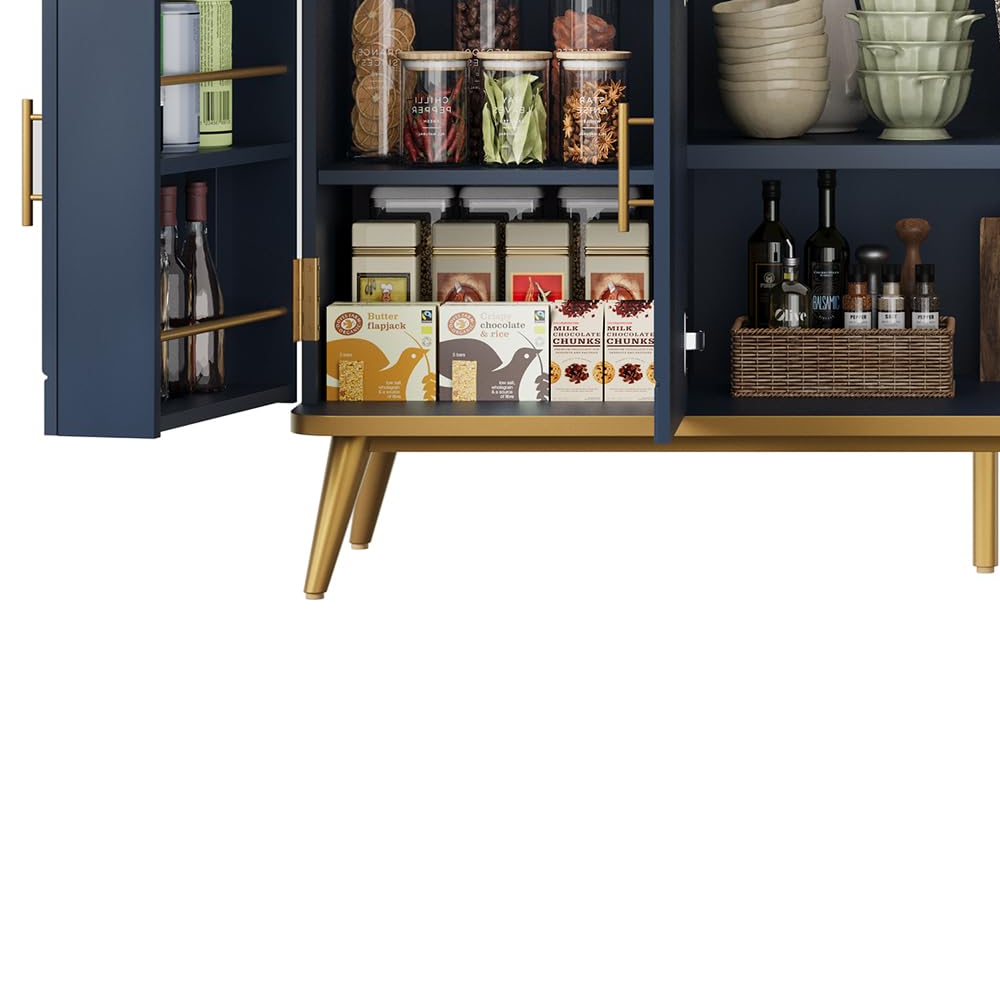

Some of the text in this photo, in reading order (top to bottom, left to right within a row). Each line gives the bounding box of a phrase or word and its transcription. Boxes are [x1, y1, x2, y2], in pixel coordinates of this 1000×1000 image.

[812, 295, 840, 310] BALSAMIC
[367, 312, 399, 320] Butter
[774, 308, 807, 322] Olive
[367, 322, 406, 332] flapjack
[480, 330, 510, 338] & rice
